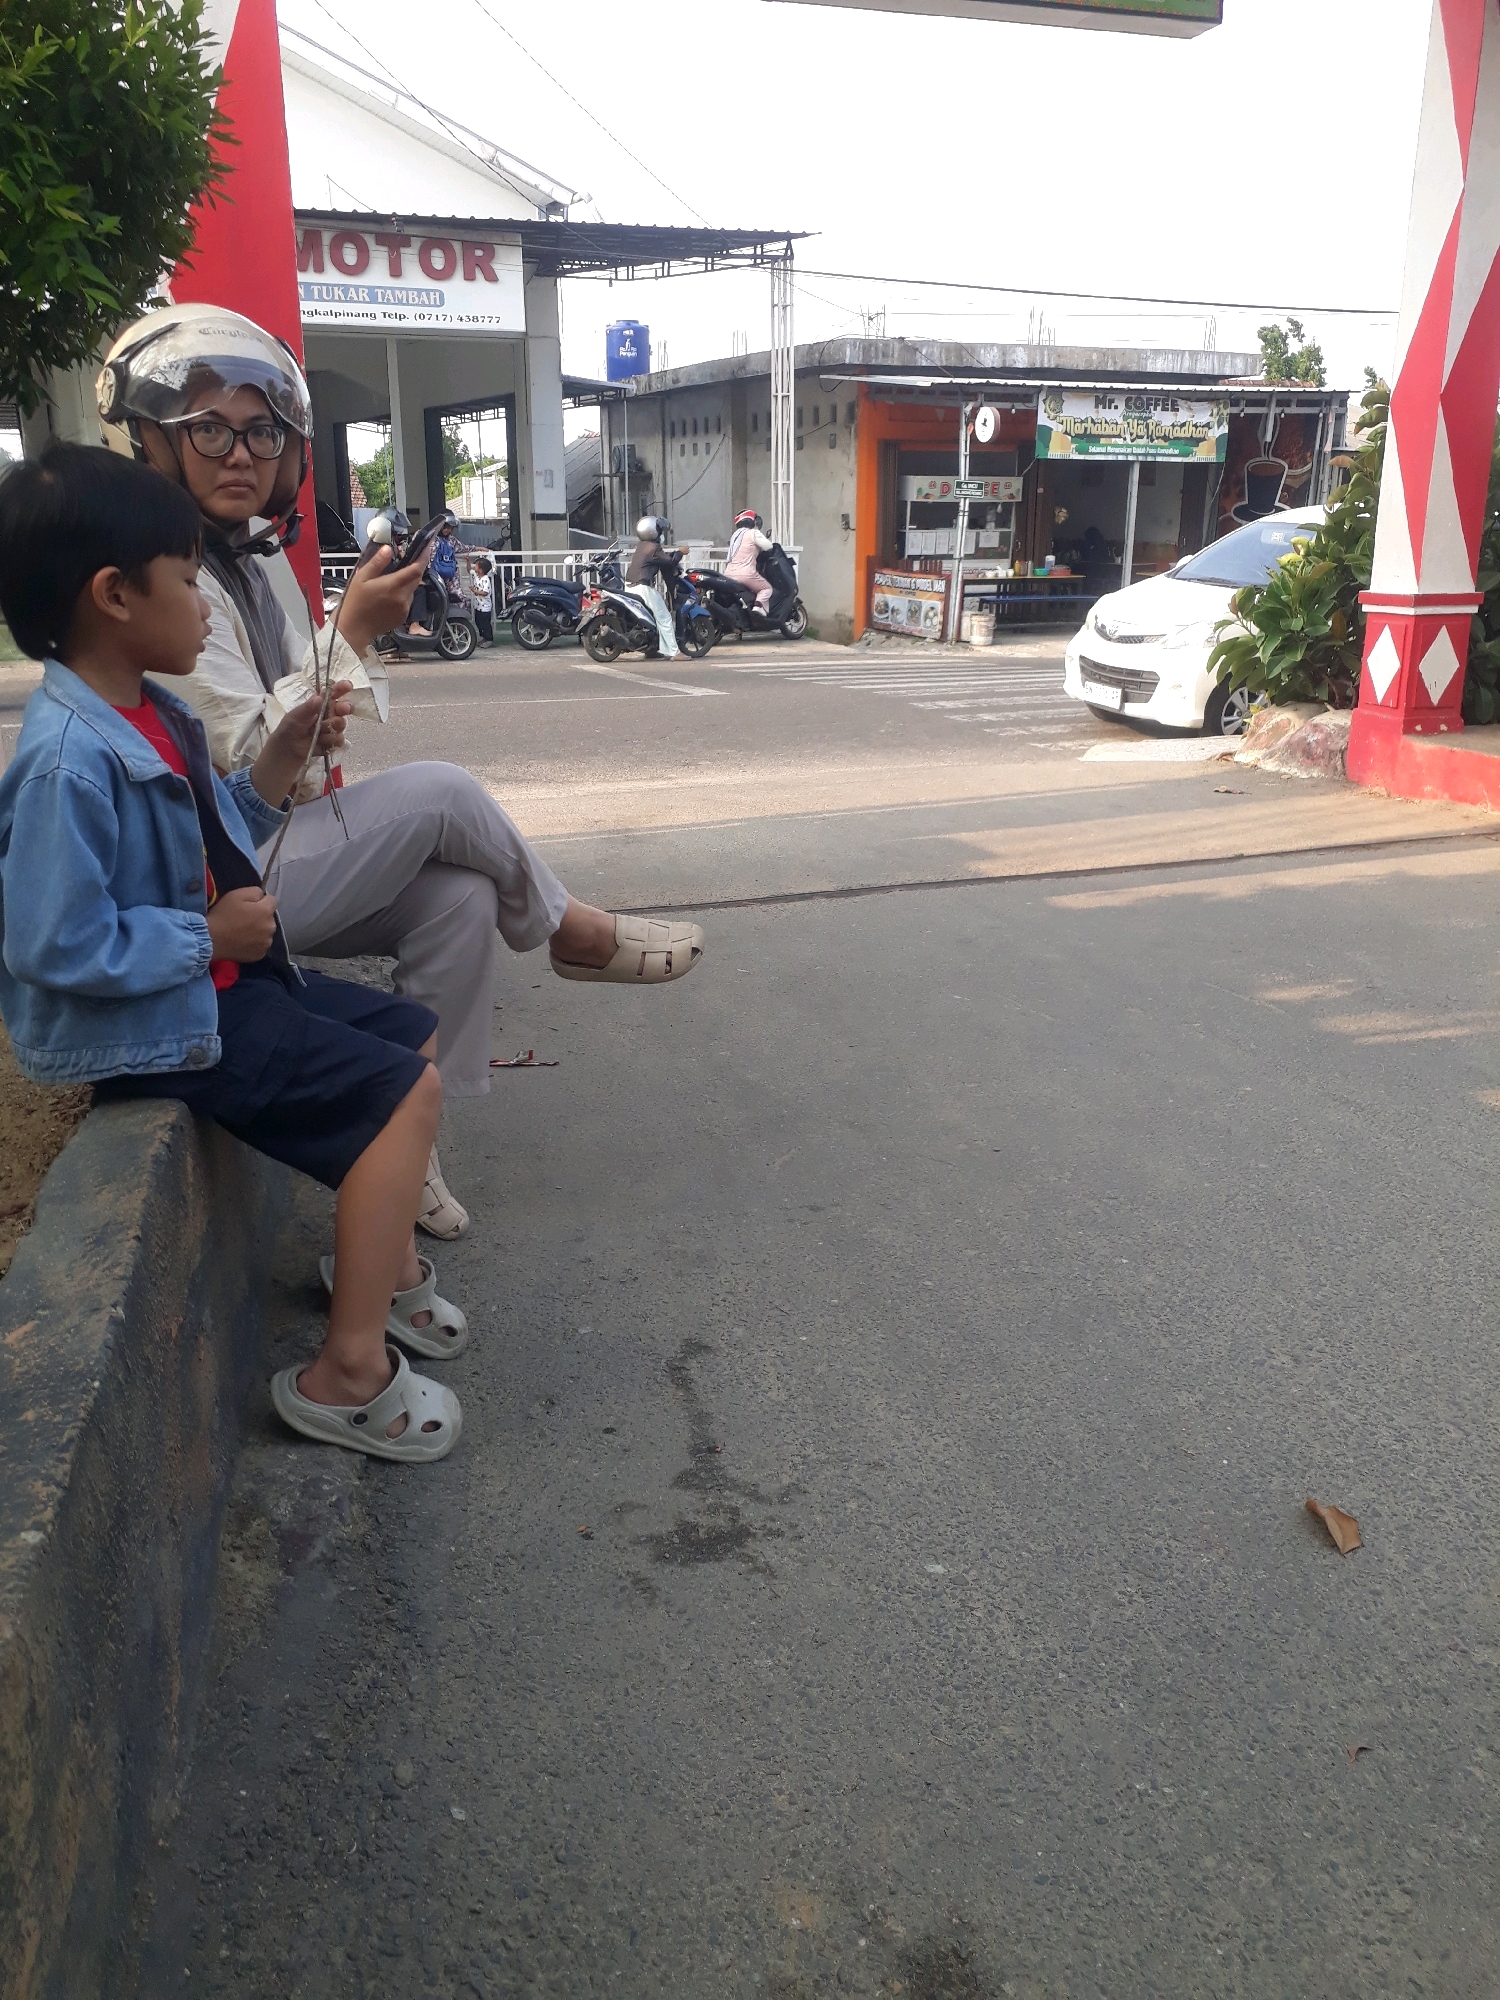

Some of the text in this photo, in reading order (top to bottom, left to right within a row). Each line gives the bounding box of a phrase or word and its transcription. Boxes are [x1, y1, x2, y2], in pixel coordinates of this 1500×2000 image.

[296, 229, 499, 282] MOTOR
[310, 285, 371, 302] TUKAR
[374, 288, 441, 306] TAMBAH
[300, 308, 501, 324] ngkalpinang Telp. (0717) 438777
[1094, 395, 1180, 412] Mr. COFFEE
